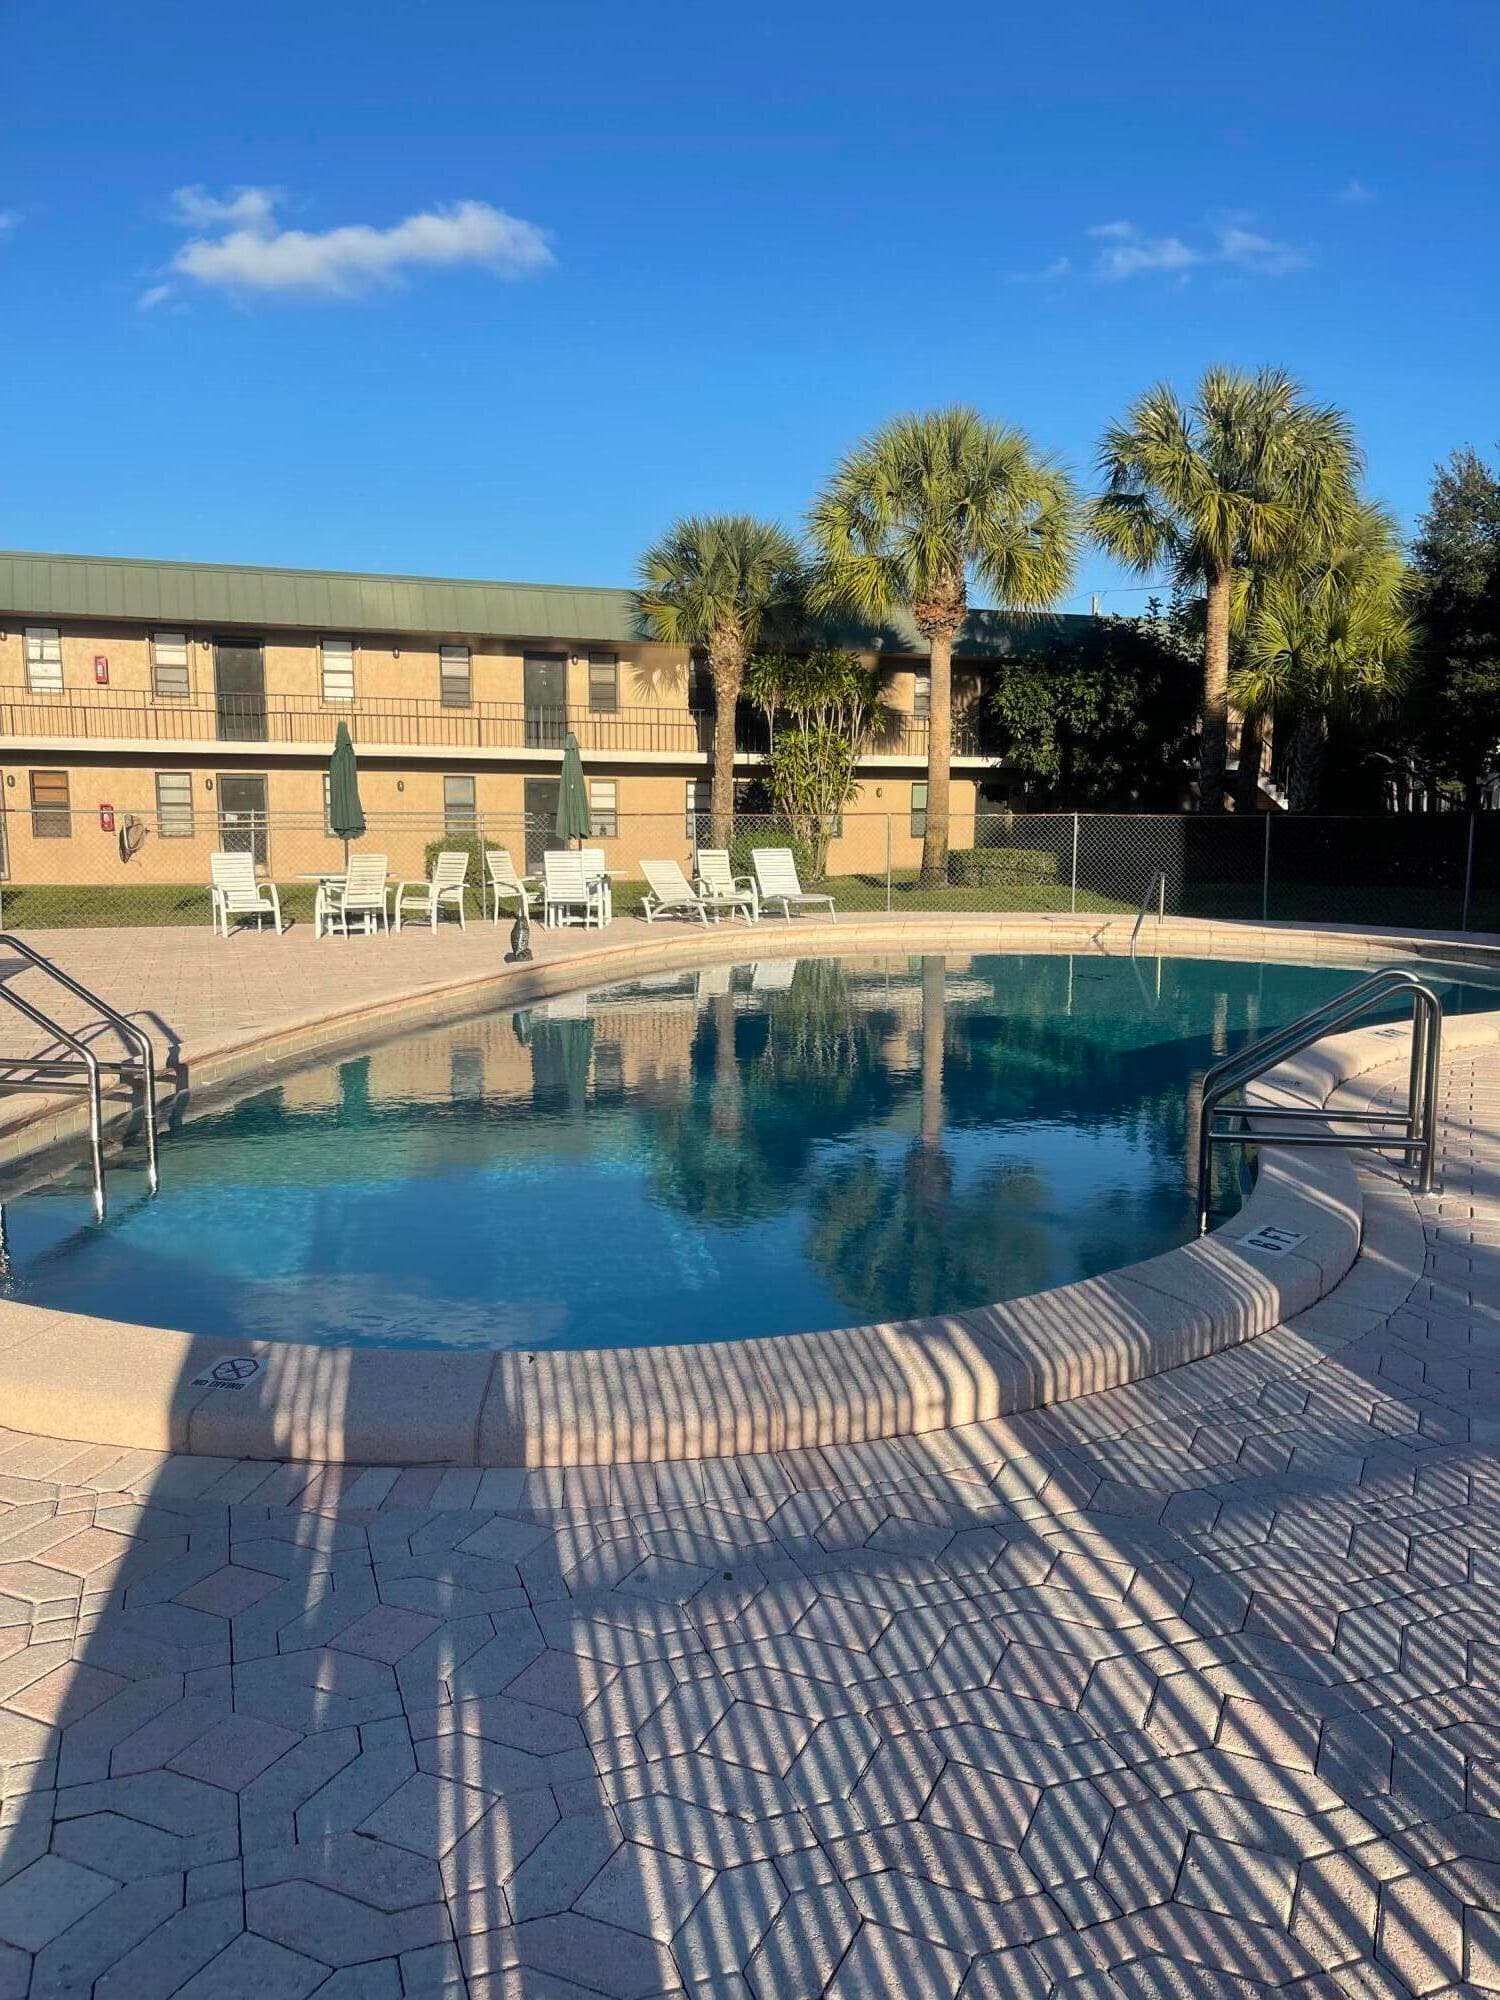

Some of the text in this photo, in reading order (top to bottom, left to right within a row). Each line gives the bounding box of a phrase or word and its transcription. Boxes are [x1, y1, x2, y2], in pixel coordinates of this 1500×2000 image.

[1248, 1226, 1302, 1250] 6 FT
[209, 1380, 245, 1390] DIVING
